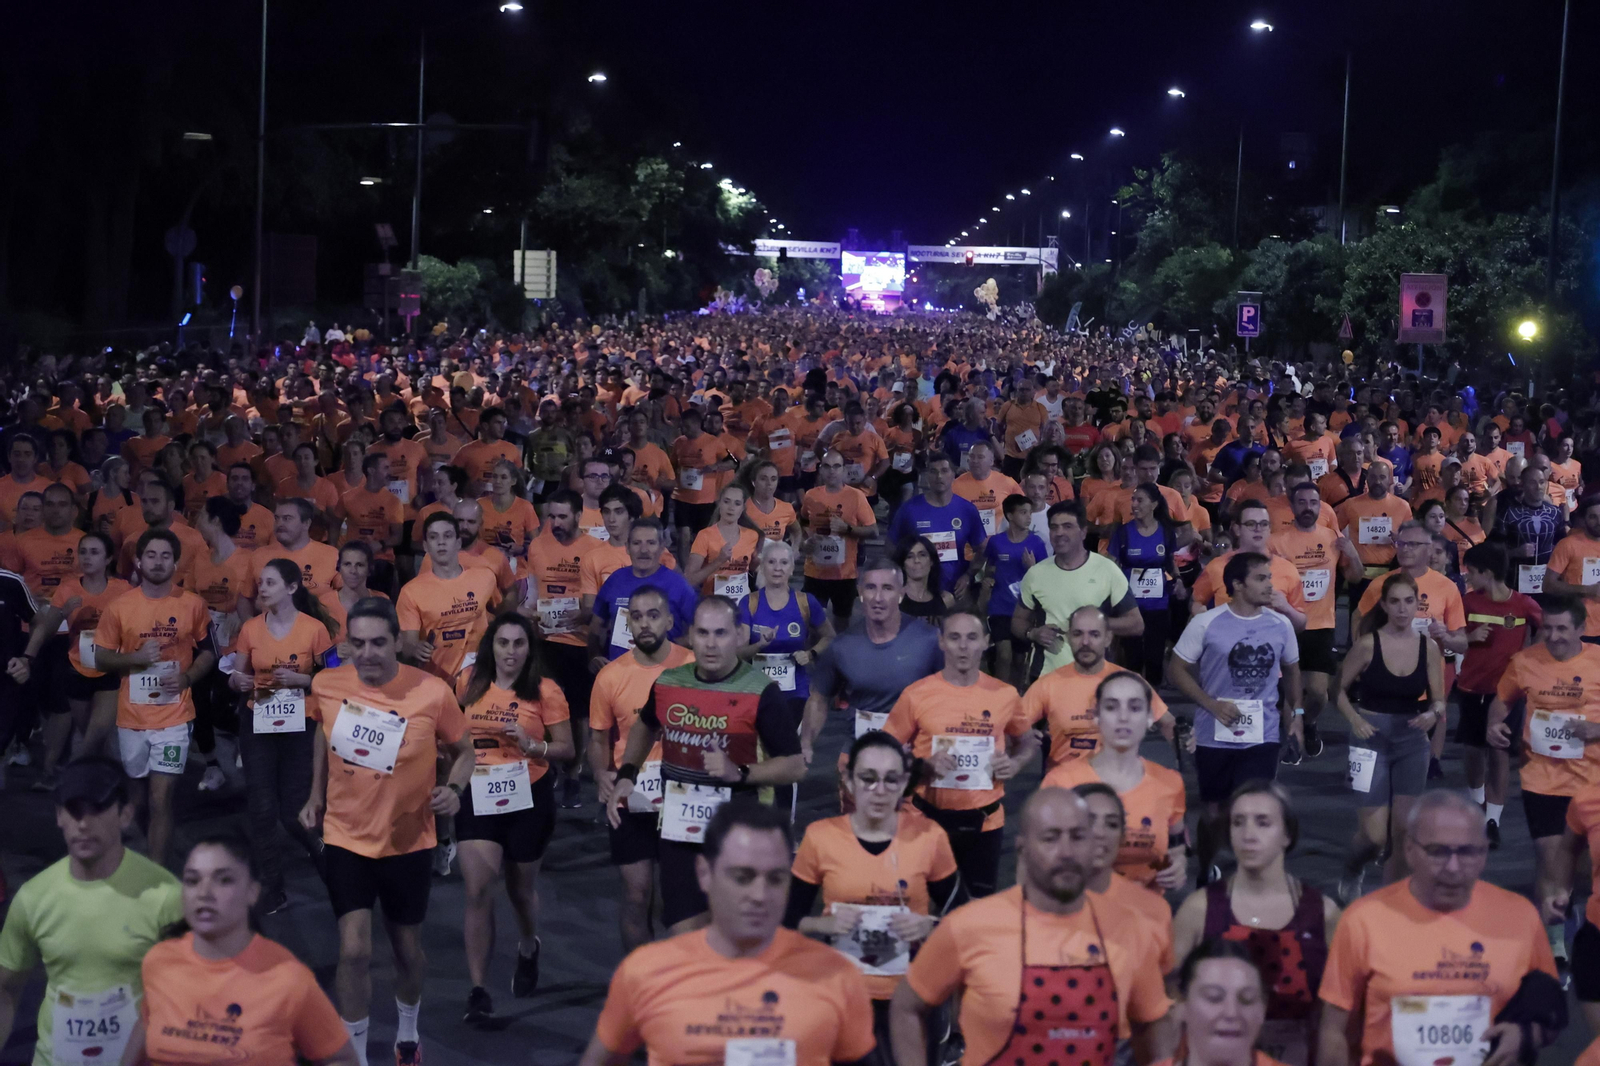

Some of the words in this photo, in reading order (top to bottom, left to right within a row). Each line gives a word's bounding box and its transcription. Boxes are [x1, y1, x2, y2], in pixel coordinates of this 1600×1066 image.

[910, 250, 950, 258] NOCTURNA
[1242, 306, 1255, 322] P
[1366, 525, 1386, 533] 14820
[820, 545, 840, 553] 14683
[1137, 578, 1158, 586] 17392
[1302, 580, 1323, 588] 12411
[725, 585, 744, 594] 9836
[451, 600, 479, 608] NOCTURNA
[440, 607, 465, 617] SEVILLA
[465, 604, 479, 613] KH7
[762, 665, 788, 677] 17384
[1538, 690, 1566, 698] SEVILLA
[265, 703, 295, 715] 11152
[485, 709, 520, 718] NOCTURNA
[471, 713, 499, 722] SEVILLA
[352, 723, 385, 746] 8709
[945, 726, 975, 734] SEVILLA
[975, 727, 994, 735] KH7
[1545, 726, 1571, 741] 9028
[487, 779, 516, 794] 2879
[681, 803, 712, 819] 7150
[1413, 971, 1460, 980] SEVILLA
[1463, 971, 1489, 980] KH7
[66, 1015, 121, 1038] 17245
[686, 1024, 746, 1036] SEVILLA
[162, 1025, 209, 1042] SEVILLA
[210, 1032, 241, 1047] KH7
[1417, 1024, 1473, 1044] 10806
